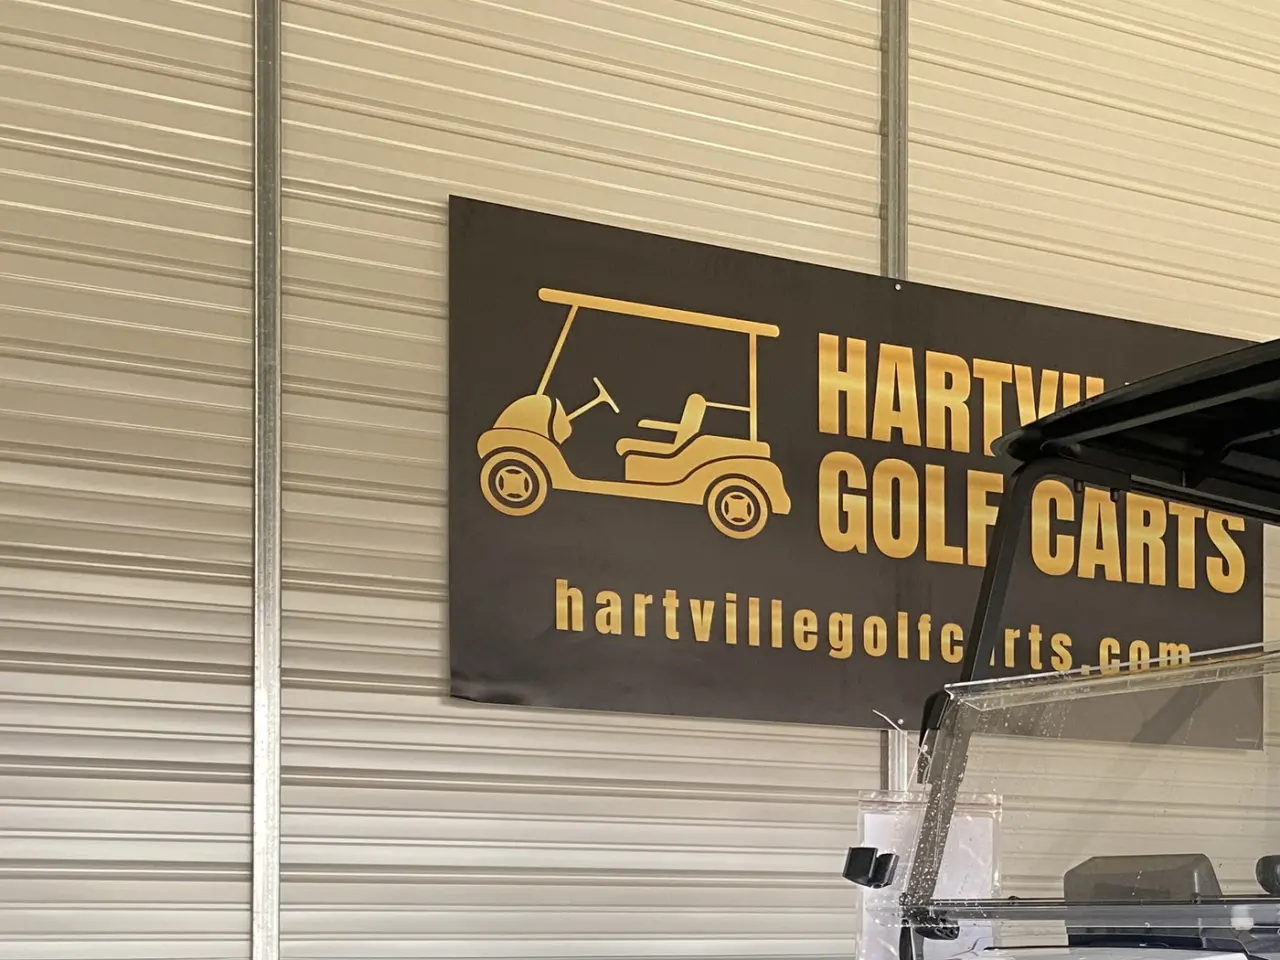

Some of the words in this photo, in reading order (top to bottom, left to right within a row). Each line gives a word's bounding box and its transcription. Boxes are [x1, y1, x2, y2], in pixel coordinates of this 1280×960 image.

[818, 450, 1004, 568] GOLF
[1031, 479, 1246, 594] CARTS
[555, 578, 1191, 676] hartvillegolfcrts.com
